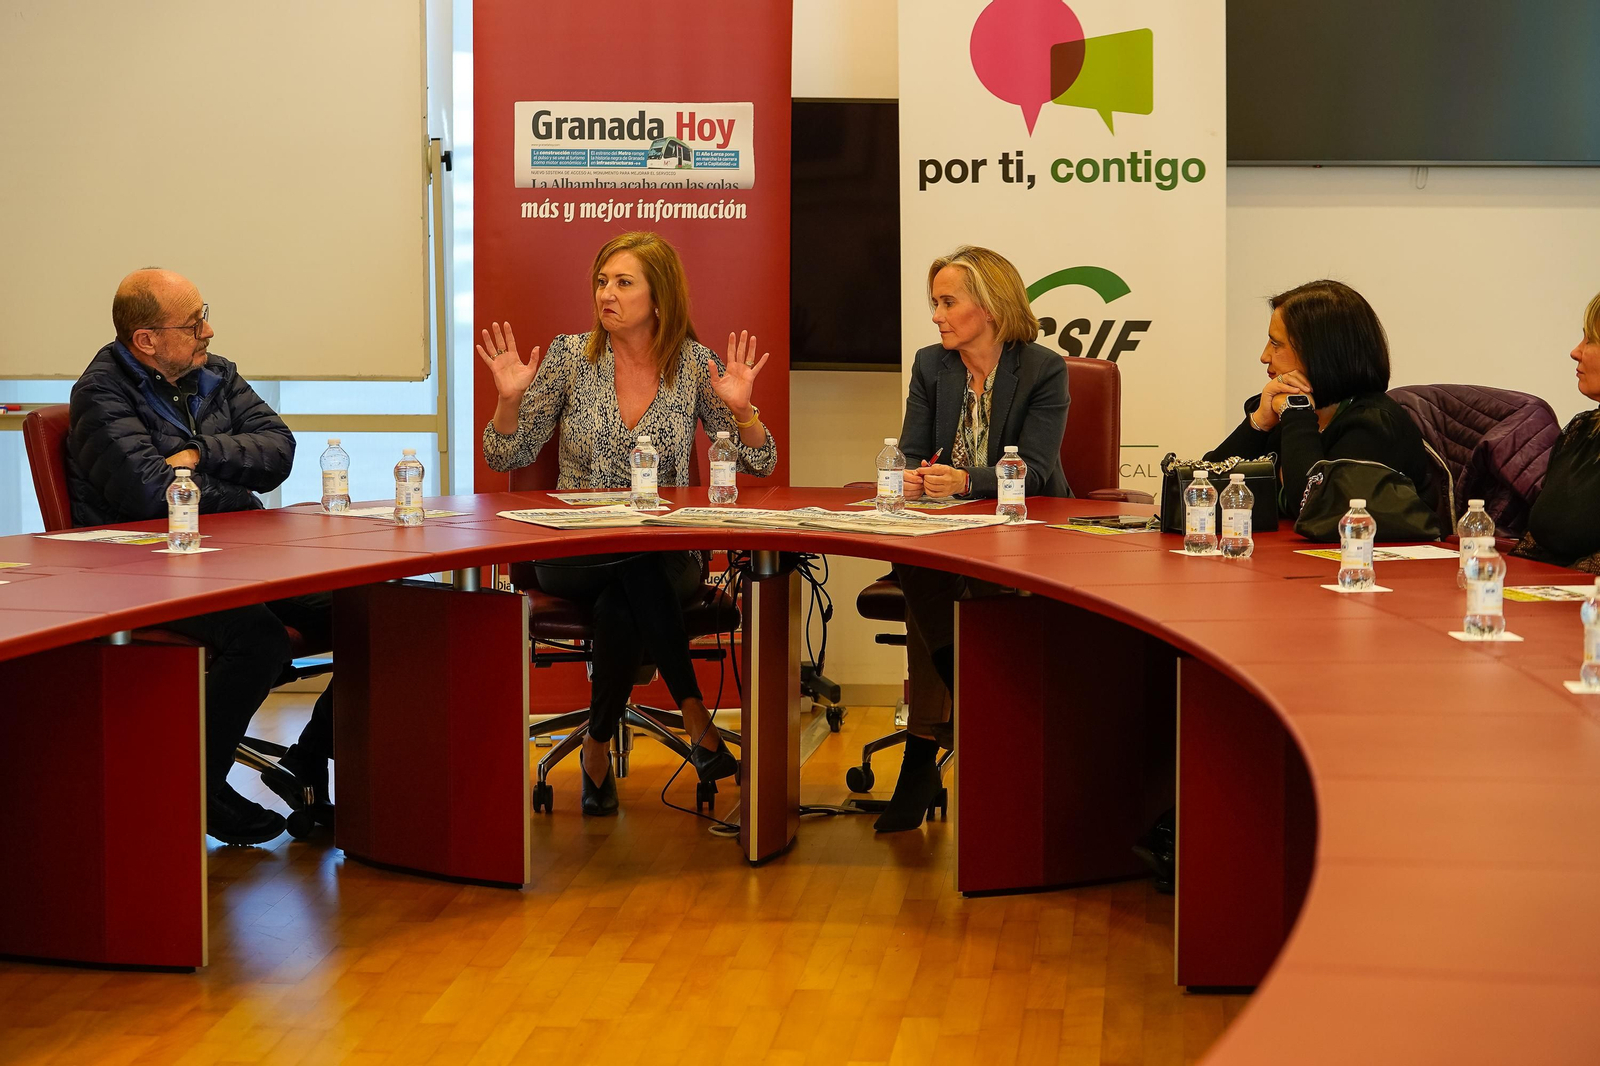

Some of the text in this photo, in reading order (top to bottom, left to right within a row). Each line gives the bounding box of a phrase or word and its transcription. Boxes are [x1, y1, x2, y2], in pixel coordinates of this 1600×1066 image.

[531, 110, 736, 149] Granada Hoy
[551, 177, 616, 188] Alhambra
[620, 178, 657, 188] acaba
[686, 178, 704, 189] las
[707, 178, 738, 189] colas
[919, 150, 1206, 191] por ti, contigo
[521, 198, 747, 223] más y mejor información
